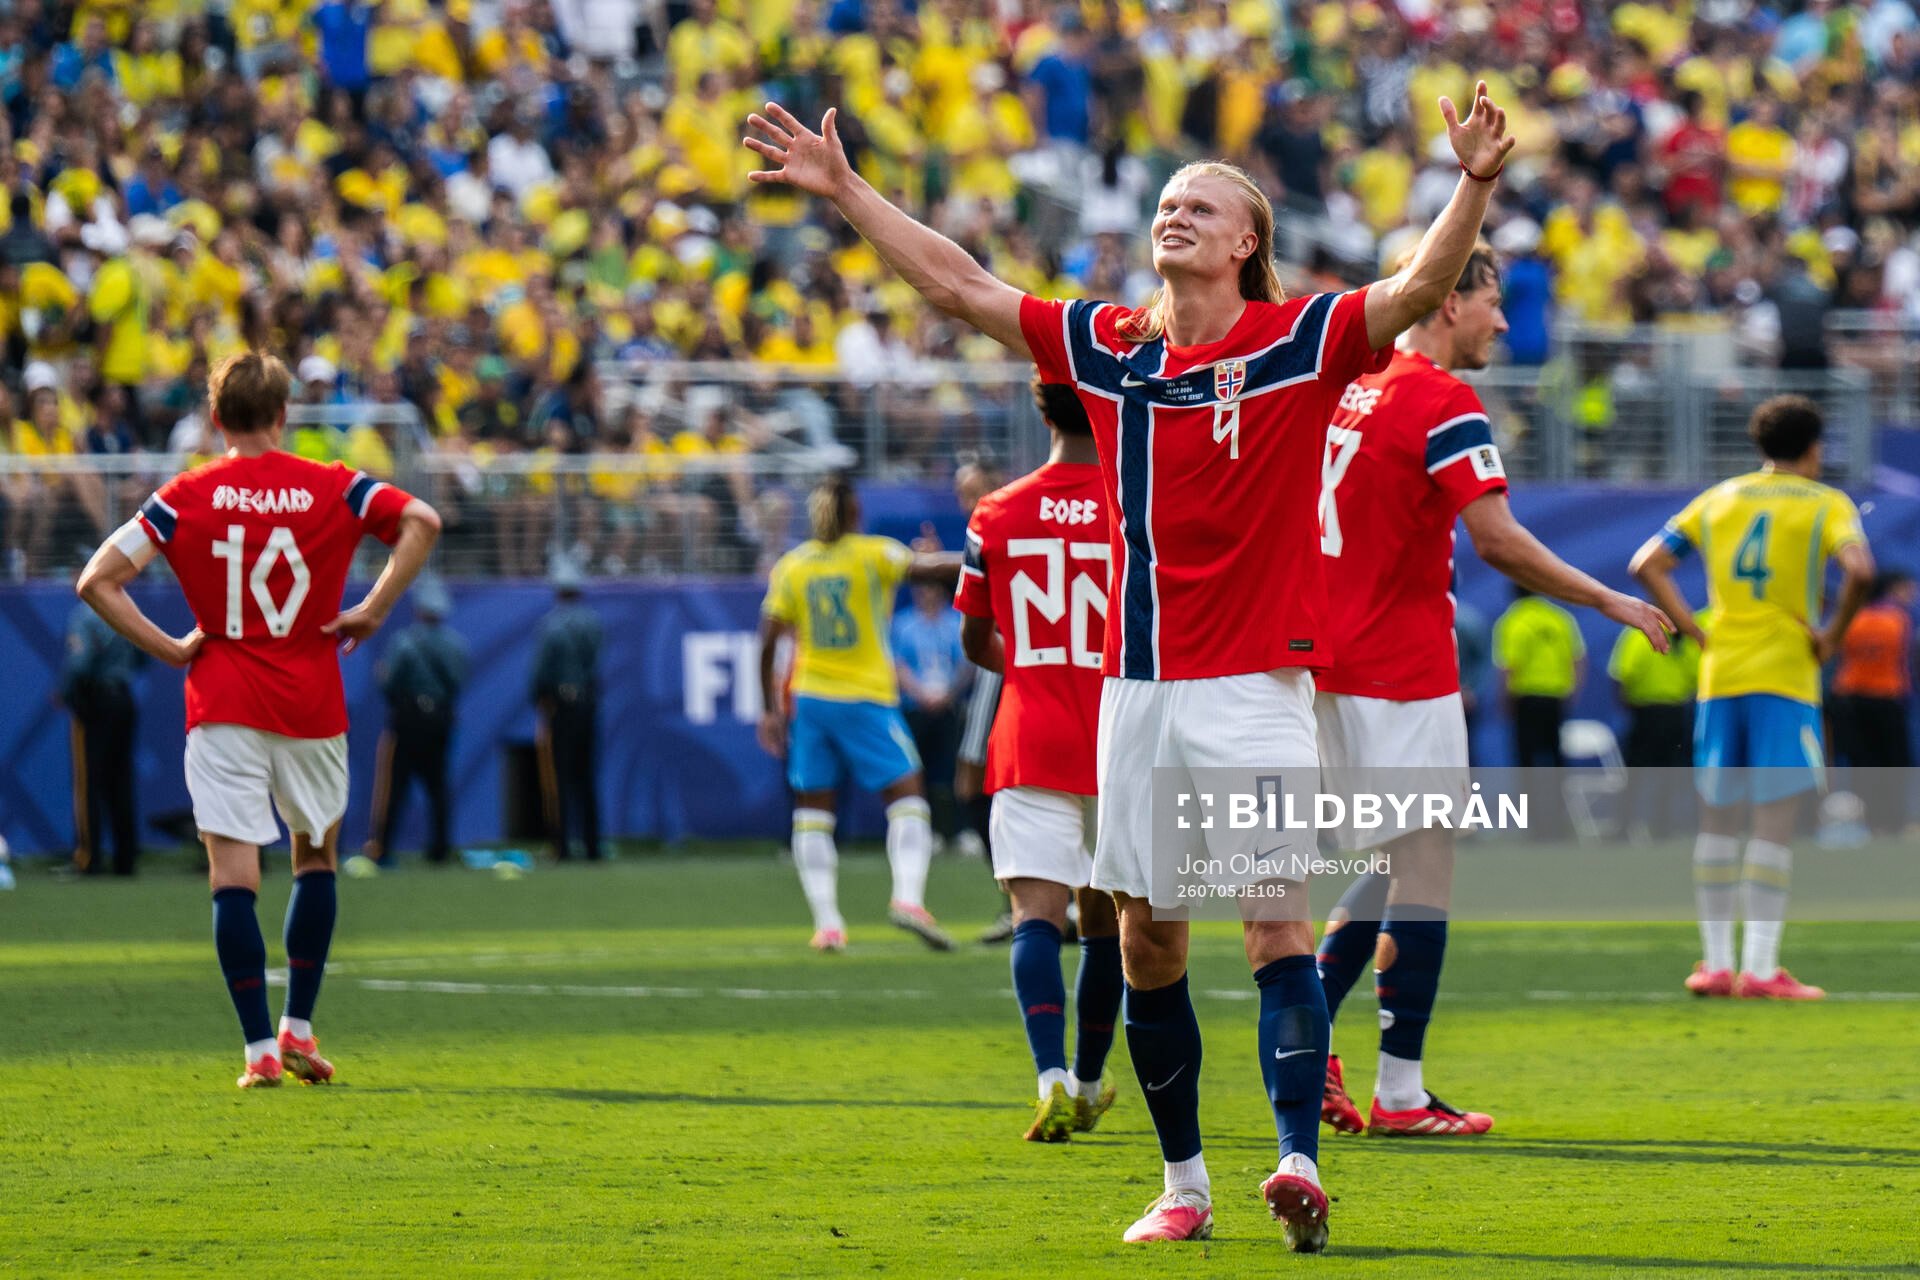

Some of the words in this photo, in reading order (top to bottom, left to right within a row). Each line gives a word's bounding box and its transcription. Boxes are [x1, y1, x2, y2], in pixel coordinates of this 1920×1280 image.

[1213, 402, 1240, 460] 9
[212, 485, 314, 512] ØDEGAARD
[1039, 495, 1099, 526] BOBB
[212, 524, 311, 638] 10
[1733, 513, 1772, 600] 4
[1007, 537, 1113, 670] 22
